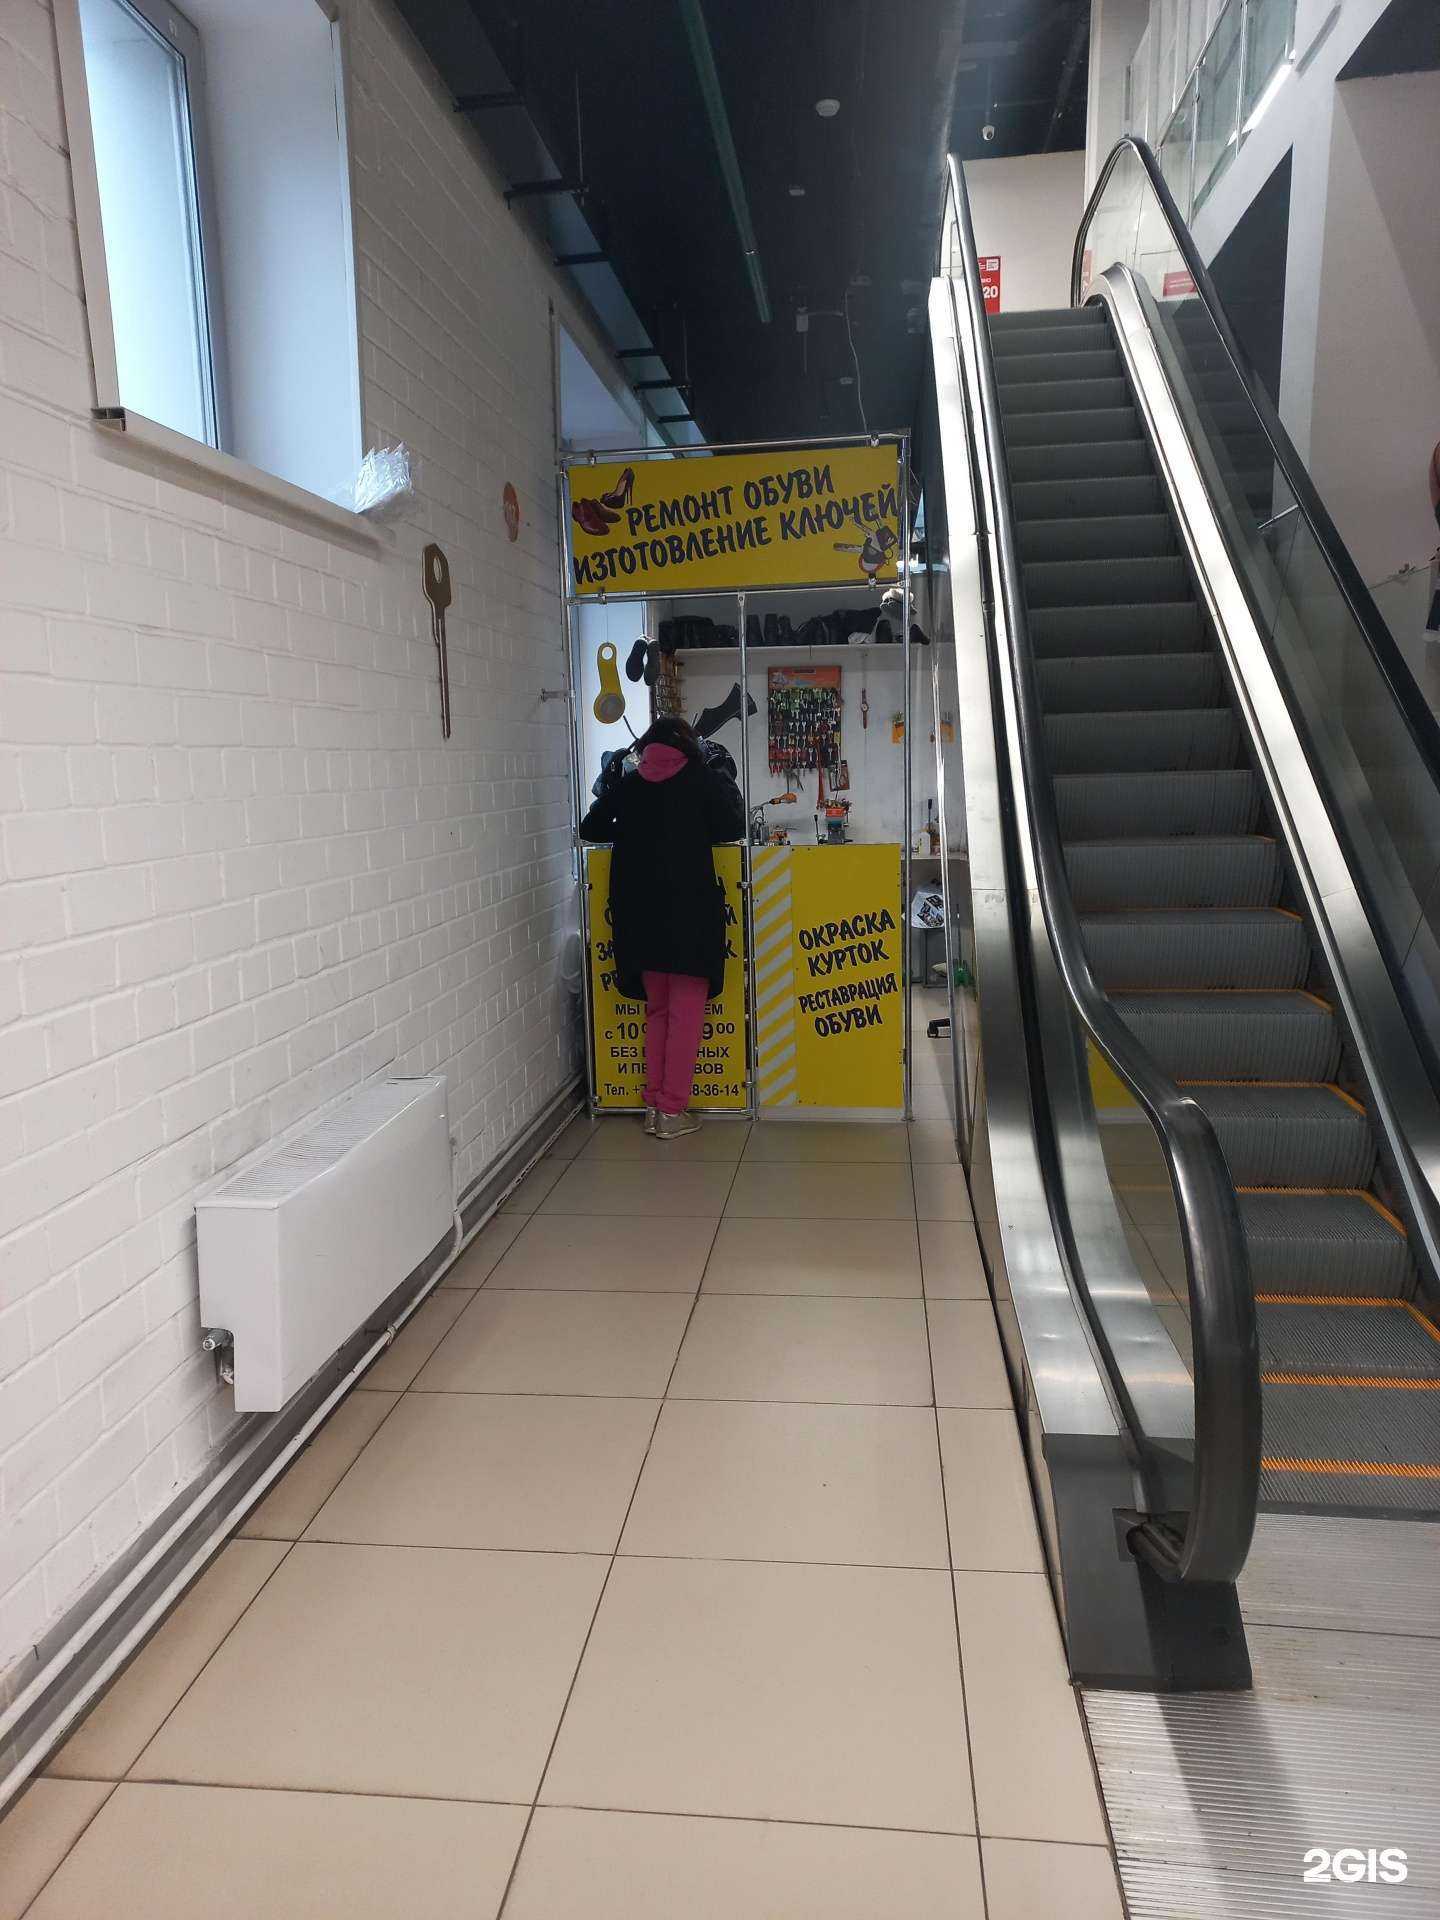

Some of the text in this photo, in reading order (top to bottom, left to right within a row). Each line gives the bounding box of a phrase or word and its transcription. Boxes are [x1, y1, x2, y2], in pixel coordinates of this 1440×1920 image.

[626, 464, 834, 536] РЕМОНТ ОБУВИ
[573, 482, 899, 585] ИЗГОТОВЛЕНИЕ КЛЮЧЕЙ
[798, 908, 896, 951] ОКРАСКА
[807, 938, 890, 977] КУРТОК
[615, 1003, 640, 1016] МЫ
[797, 972, 898, 1014] РЕСТАВРАЦИЯ
[814, 1004, 883, 1038] ОБУВИ
[610, 1047, 638, 1058] БЕЗ
[617, 1063, 628, 1074] И
[604, 1083, 629, 1097] Тел.
